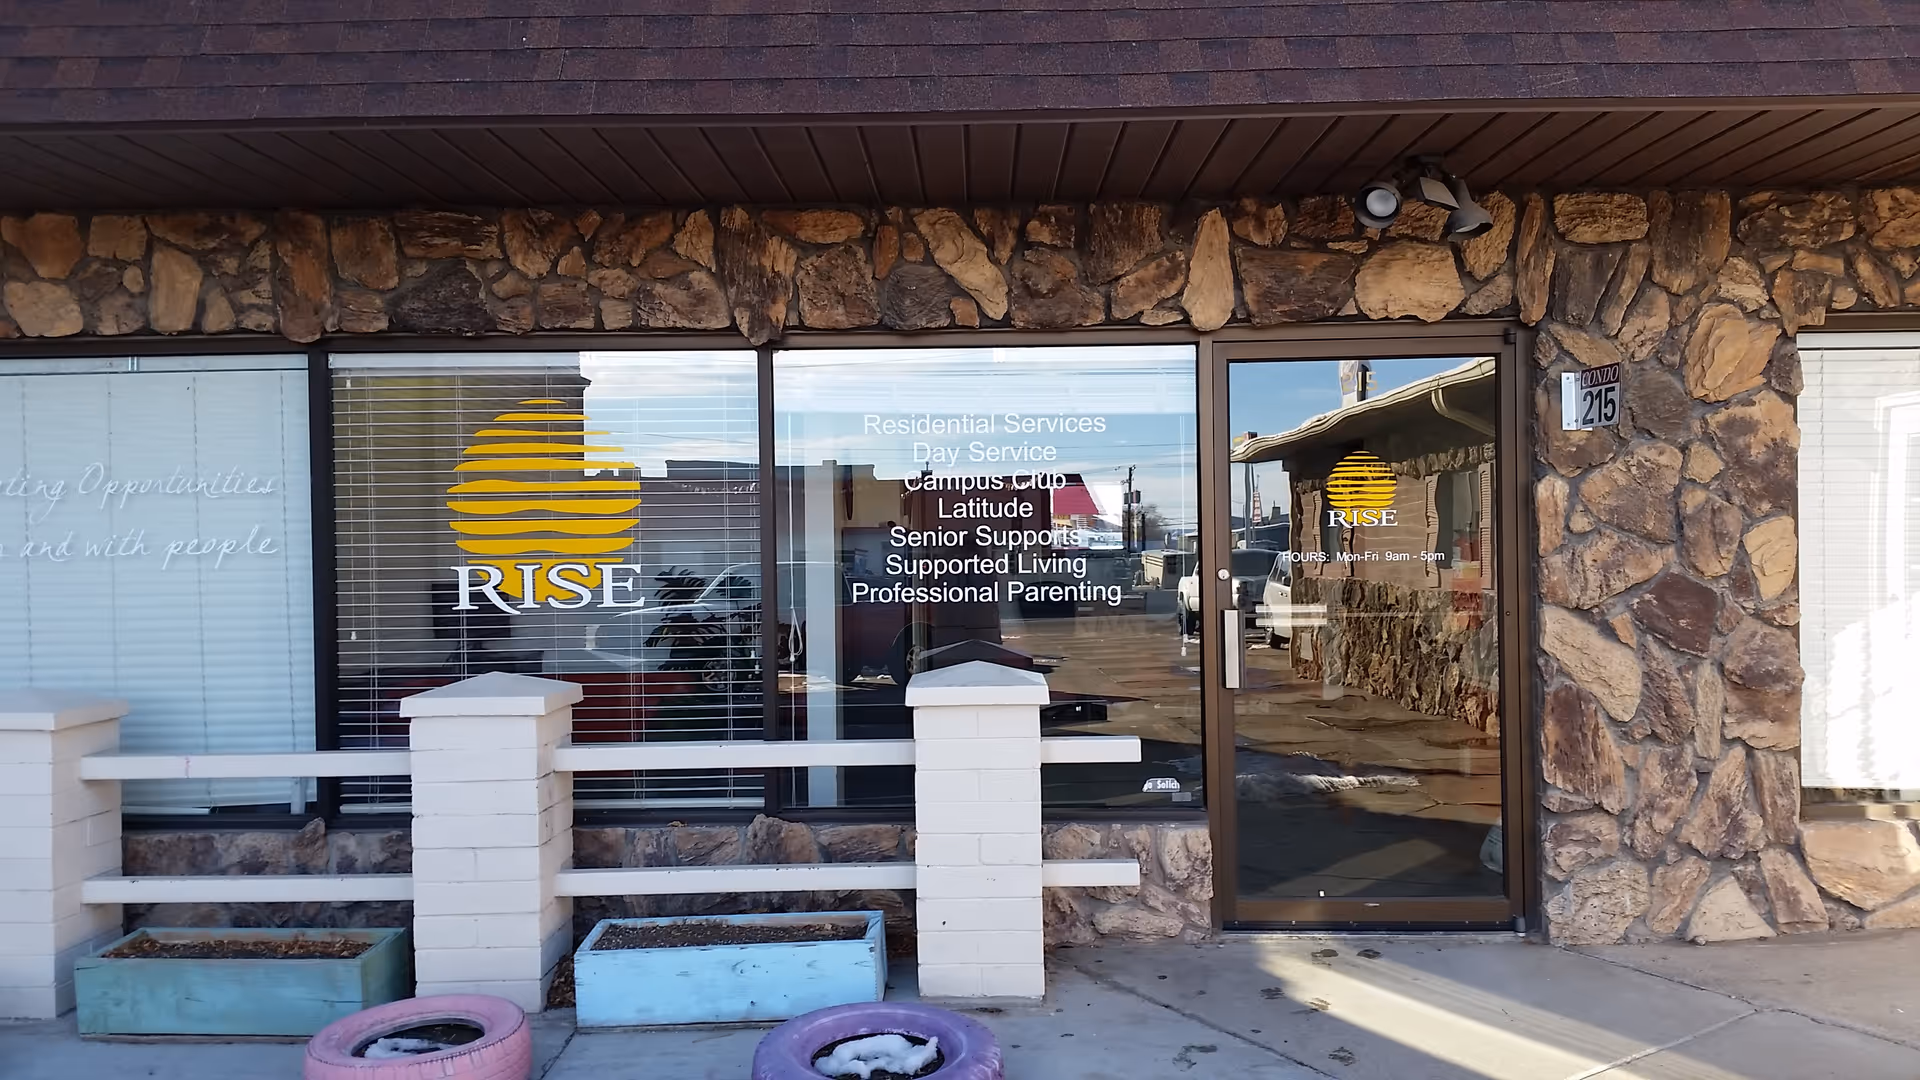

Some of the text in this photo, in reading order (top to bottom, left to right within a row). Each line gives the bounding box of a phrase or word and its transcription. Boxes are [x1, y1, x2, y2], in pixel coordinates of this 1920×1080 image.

[1342, 371, 1378, 391] 215
[1581, 365, 1619, 387] CONDO
[1582, 386, 1616, 425] 215
[863, 412, 1106, 435] Residential Services
[913, 441, 1057, 467] Day Service
[78, 462, 277, 509] Opportunities
[904, 468, 1066, 495] Campus Club
[938, 497, 1034, 519] Latitude
[1327, 508, 1398, 528] RISE
[20, 531, 73, 562] and
[86, 528, 151, 557] with
[158, 524, 279, 570] people
[890, 524, 1082, 550] Senior Supports
[886, 553, 1087, 579] Supported Living
[1282, 552, 1330, 562] HOURS:
[1336, 551, 1379, 562] Mon-Fri
[1385, 551, 1410, 562] 9am
[1420, 551, 1445, 564] 5pm
[450, 564, 645, 615] RISE
[852, 581, 1122, 606] Professional Parenting
